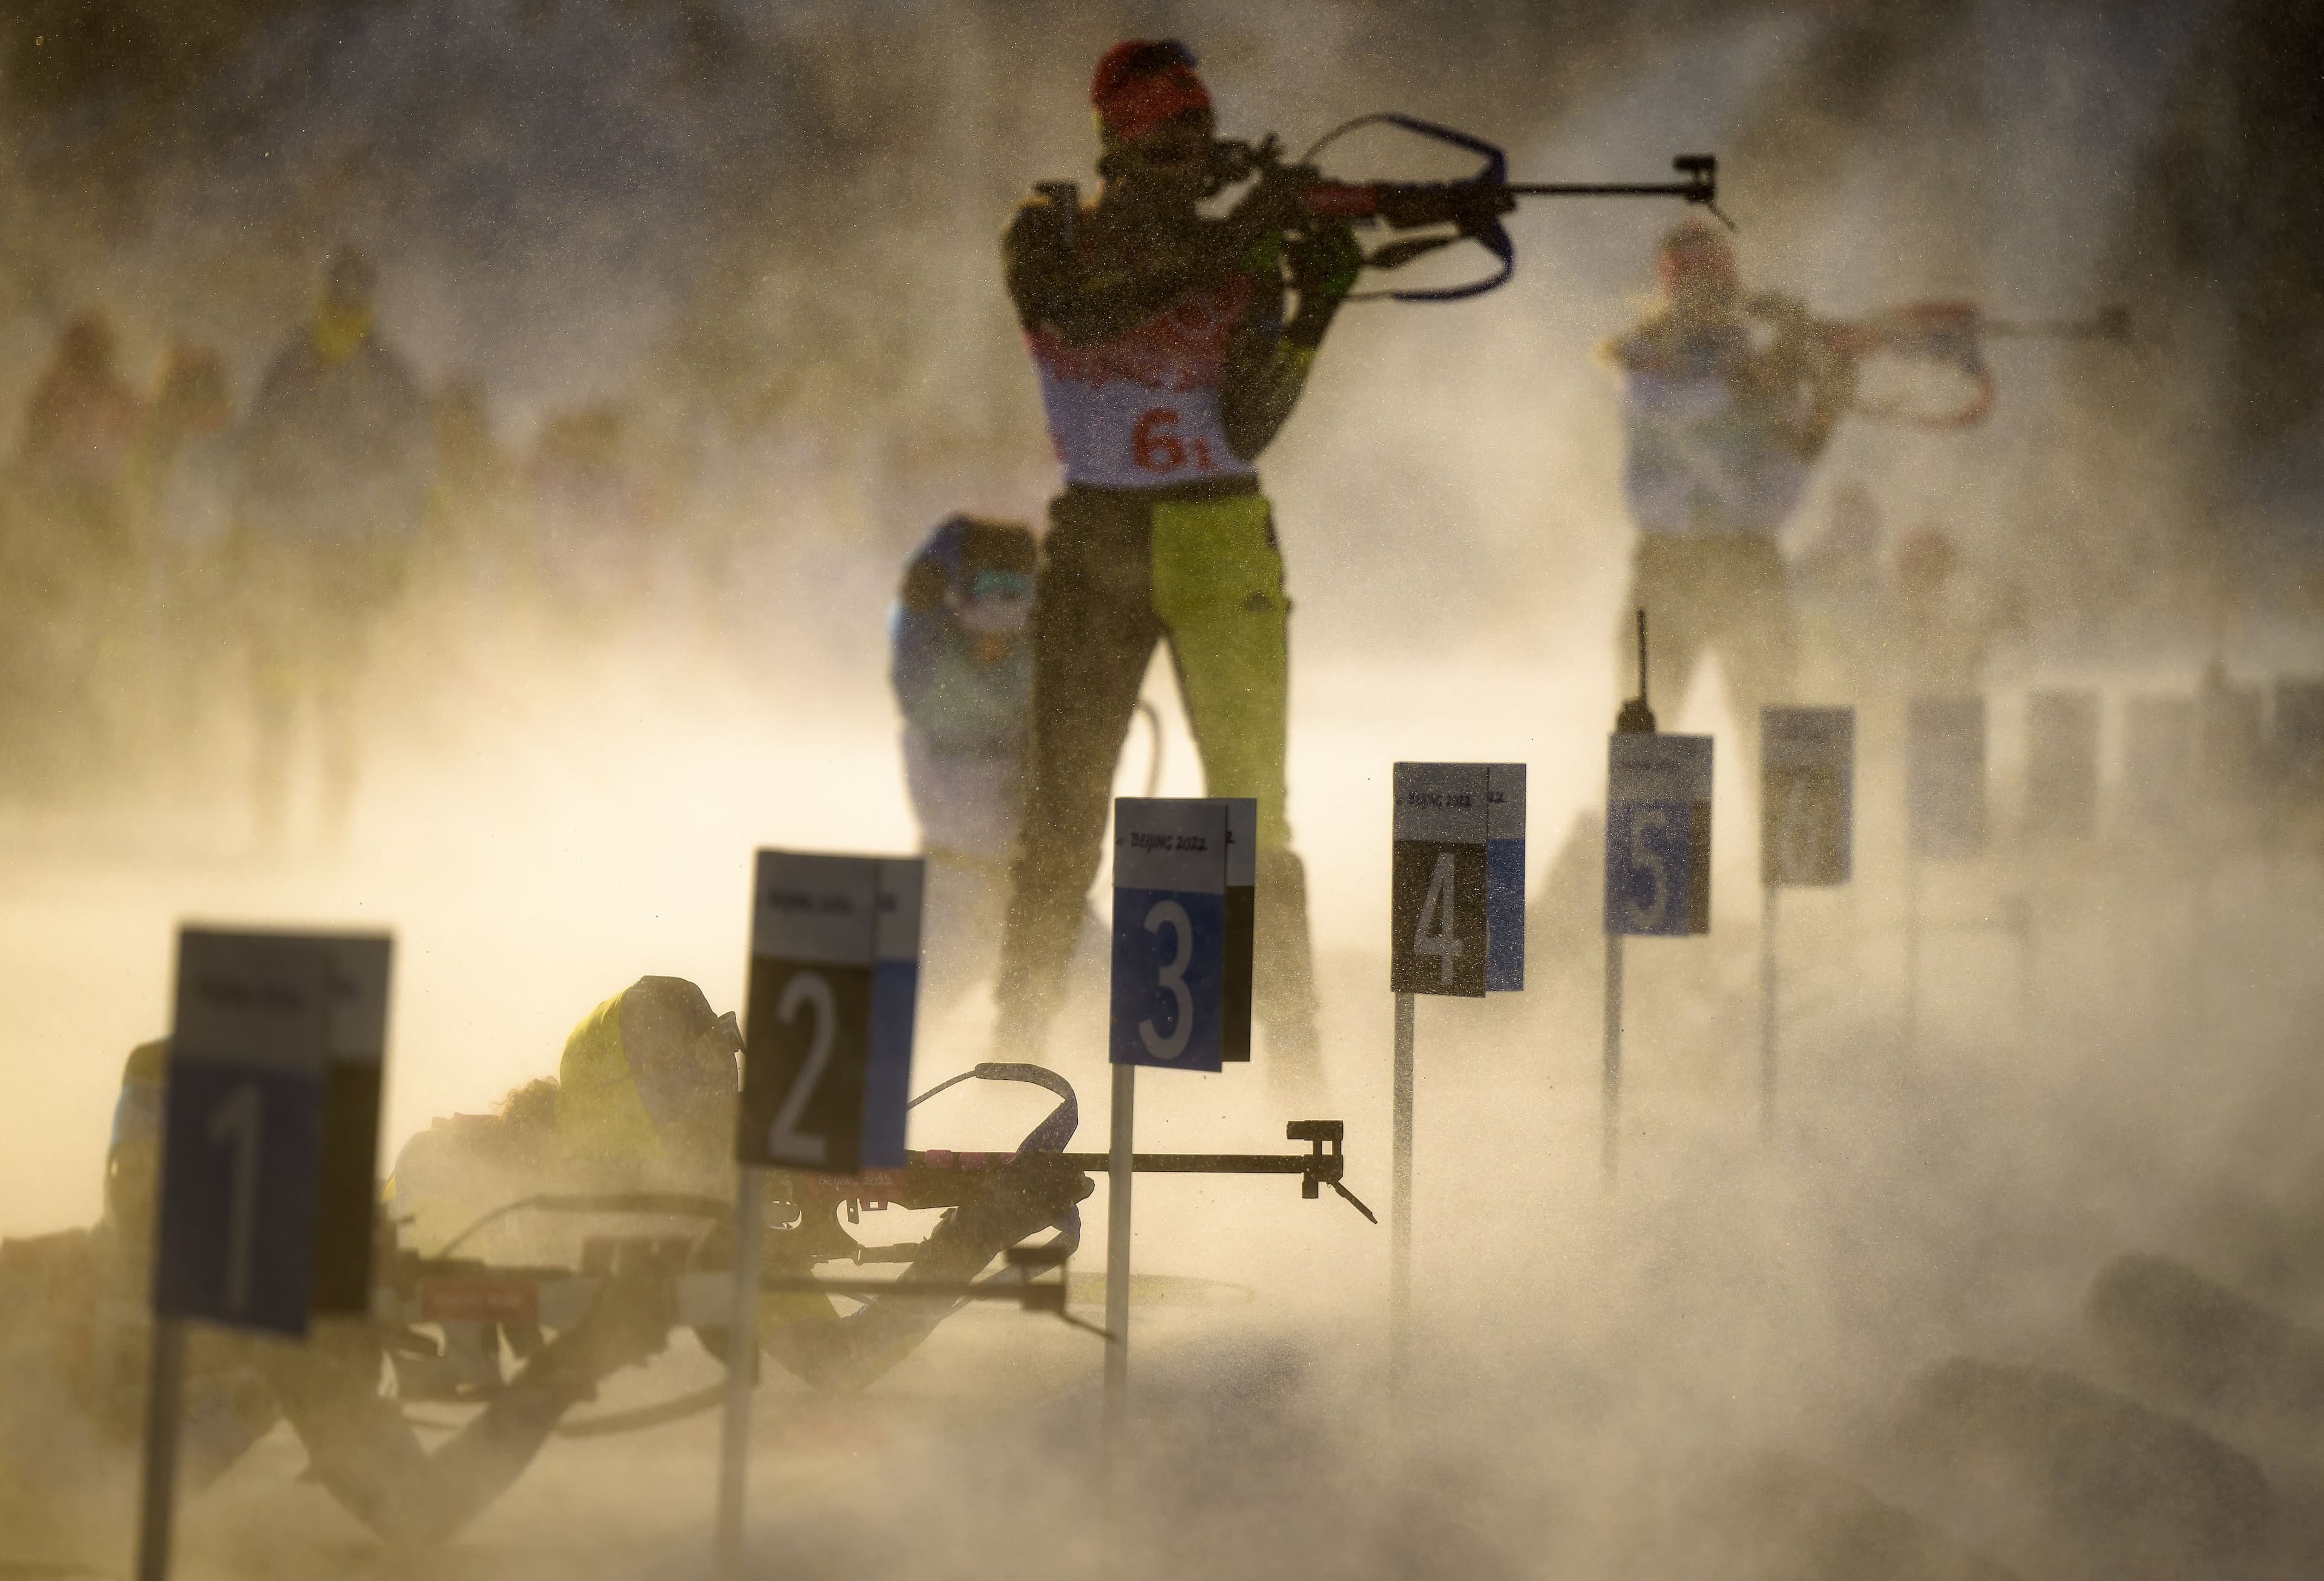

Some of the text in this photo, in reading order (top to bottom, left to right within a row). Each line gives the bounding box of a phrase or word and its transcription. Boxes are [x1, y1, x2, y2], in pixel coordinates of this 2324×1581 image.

[1131, 832, 1172, 854] BEIJING
[1176, 834, 1208, 851] 2022
[1628, 808, 1666, 928] 5
[1138, 900, 1193, 1060] 3
[1413, 851, 1464, 987] 4
[767, 973, 837, 1162] 2
[207, 1083, 264, 1318] 1
